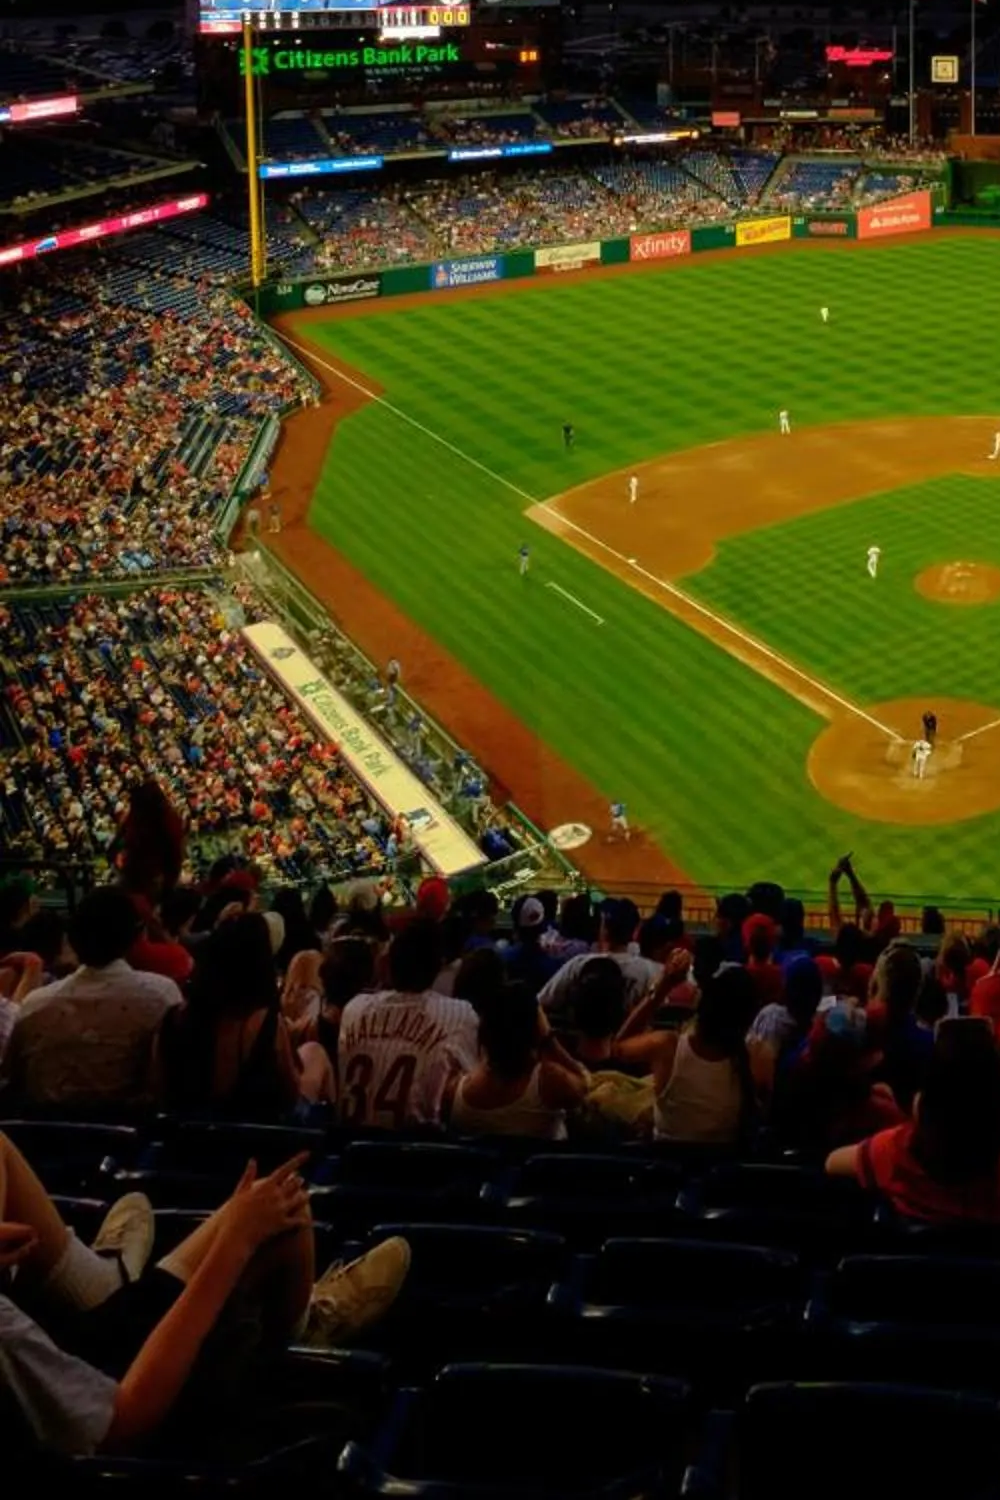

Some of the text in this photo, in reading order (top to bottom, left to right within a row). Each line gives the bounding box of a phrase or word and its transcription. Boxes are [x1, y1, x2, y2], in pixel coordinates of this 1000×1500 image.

[273, 43, 459, 69] Citizens Bank Park
[634, 235, 686, 259] xfinity
[345, 1010, 448, 1054] HALLADAY
[341, 1053, 418, 1128] 34
